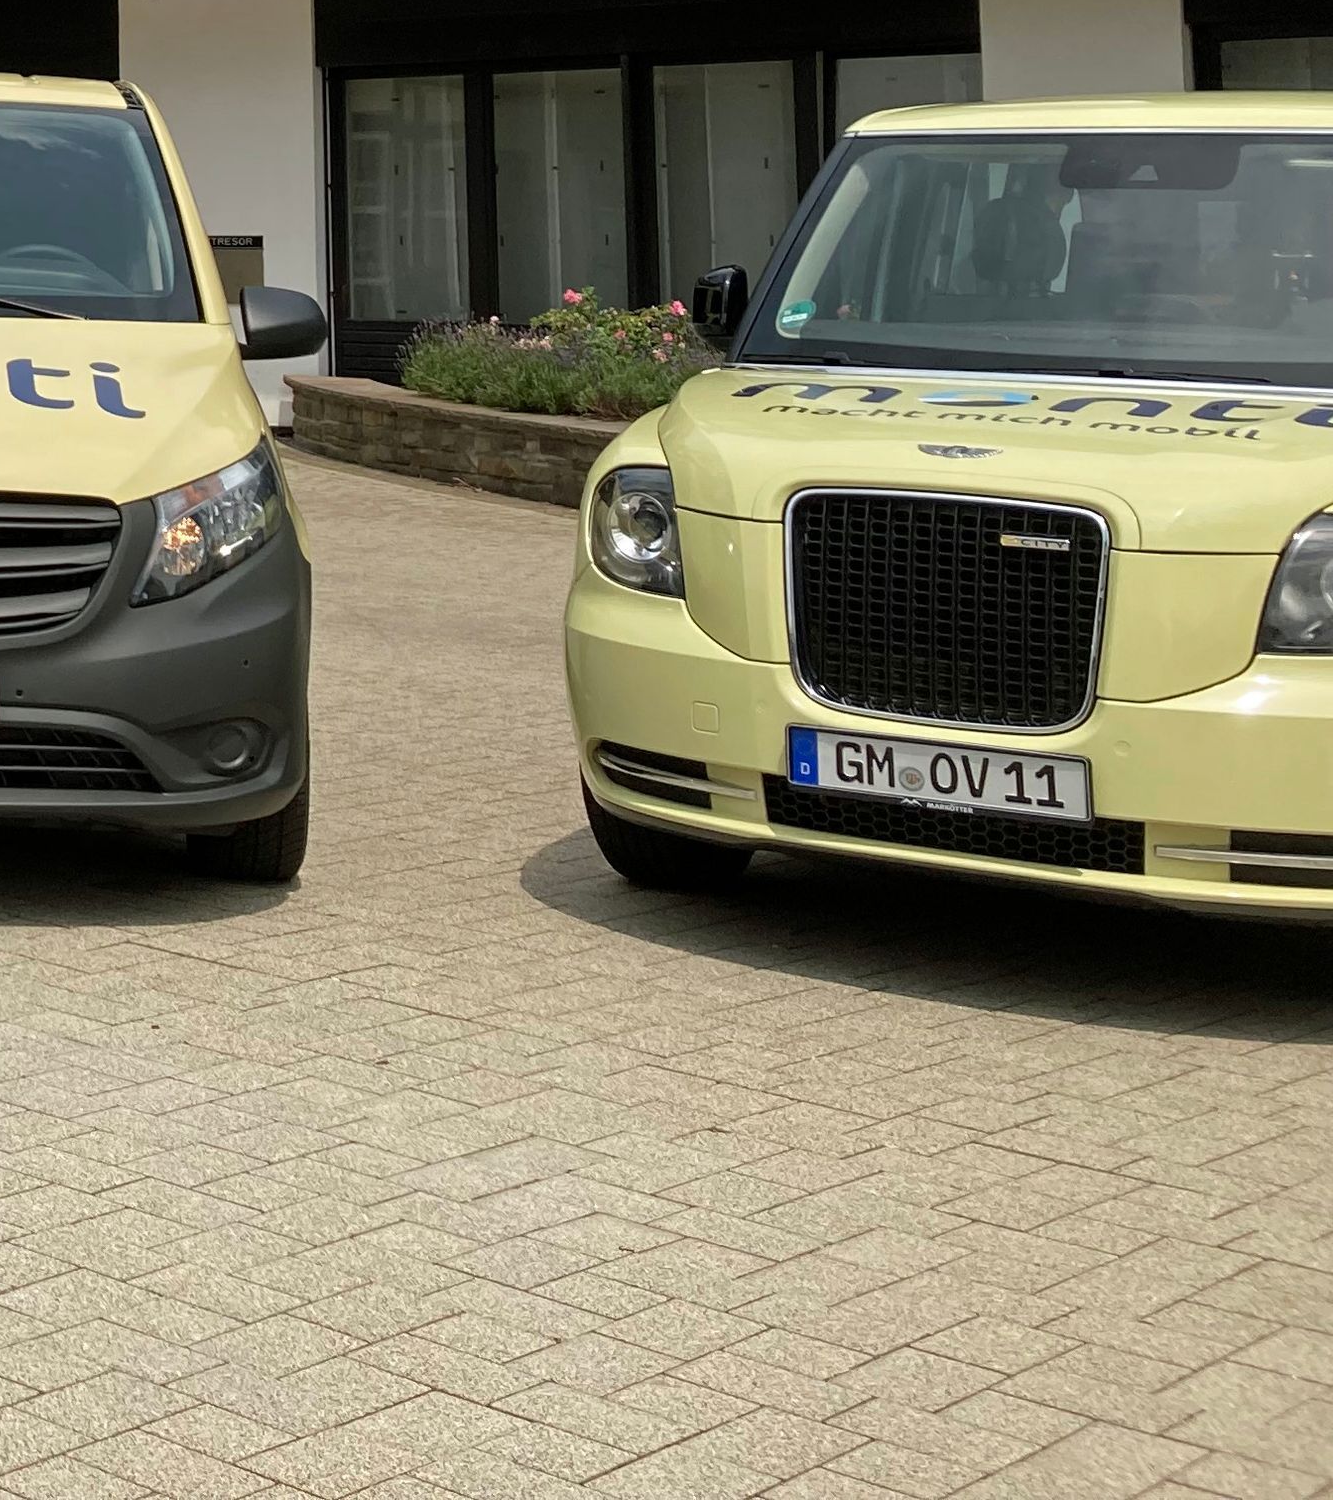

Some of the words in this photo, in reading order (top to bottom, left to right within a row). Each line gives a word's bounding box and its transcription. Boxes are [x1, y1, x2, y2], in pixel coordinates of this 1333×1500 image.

[761, 404, 927, 419] macht
[936, 411, 1073, 427] mich
[1089, 421, 1261, 441] mobil
[1020, 539, 1067, 549] CITY
[800, 761, 810, 775] D
[835, 740, 896, 788] GM
[929, 752, 990, 798] OV
[1003, 760, 1065, 809] 11
